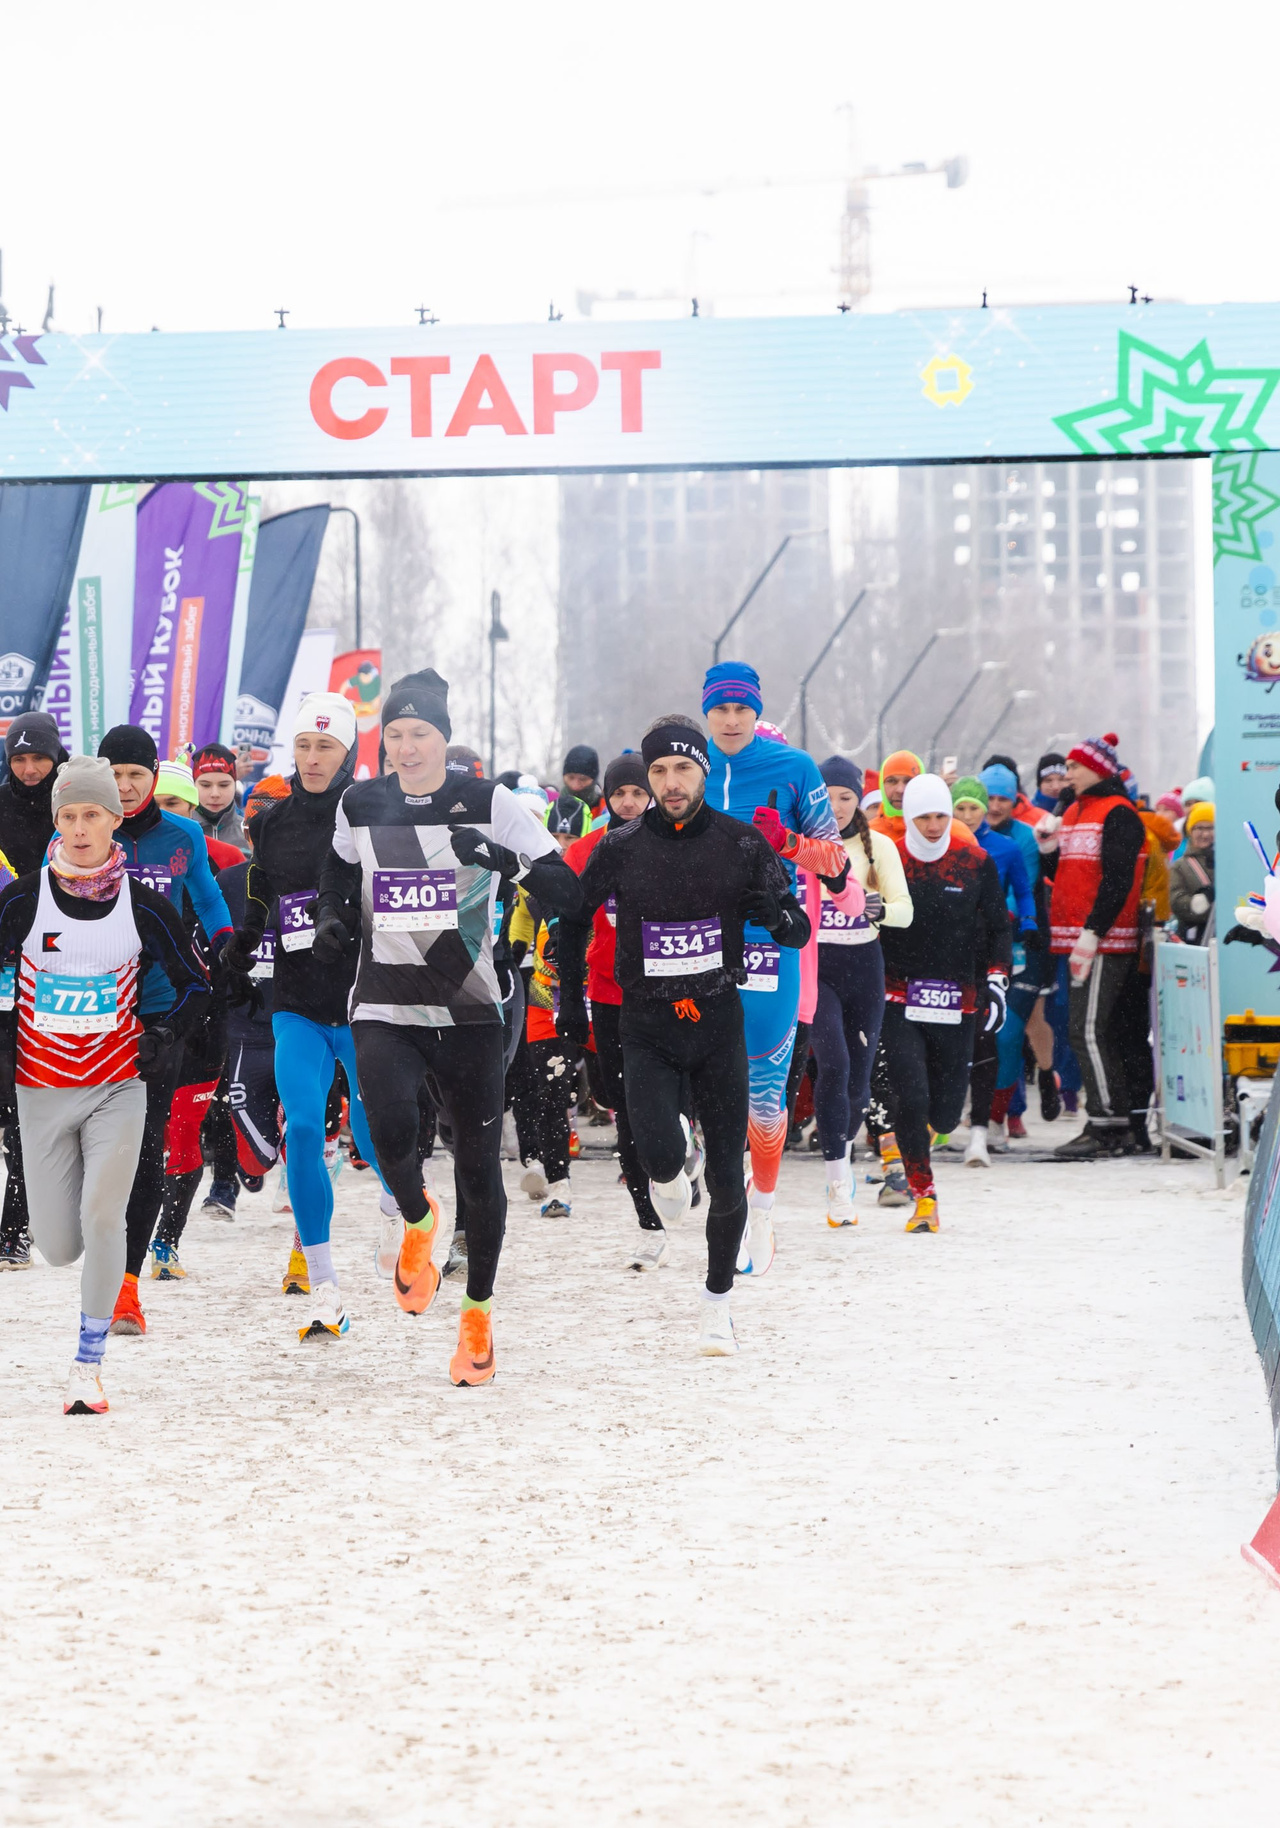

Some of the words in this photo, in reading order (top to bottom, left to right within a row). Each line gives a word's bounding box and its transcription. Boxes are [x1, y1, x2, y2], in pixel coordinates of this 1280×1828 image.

[310, 350, 661, 440] СТАРТ
[83, 583, 97, 623] забег
[150, 545, 184, 655] КУБОК
[185, 604, 198, 641] забег
[84, 625, 102, 731] многодневный
[671, 742, 689, 752] TY
[389, 885, 437, 908] 340
[250, 941, 276, 960] 41
[660, 934, 704, 955] 334
[53, 988, 98, 1012] 772
[920, 989, 950, 1007] 350
